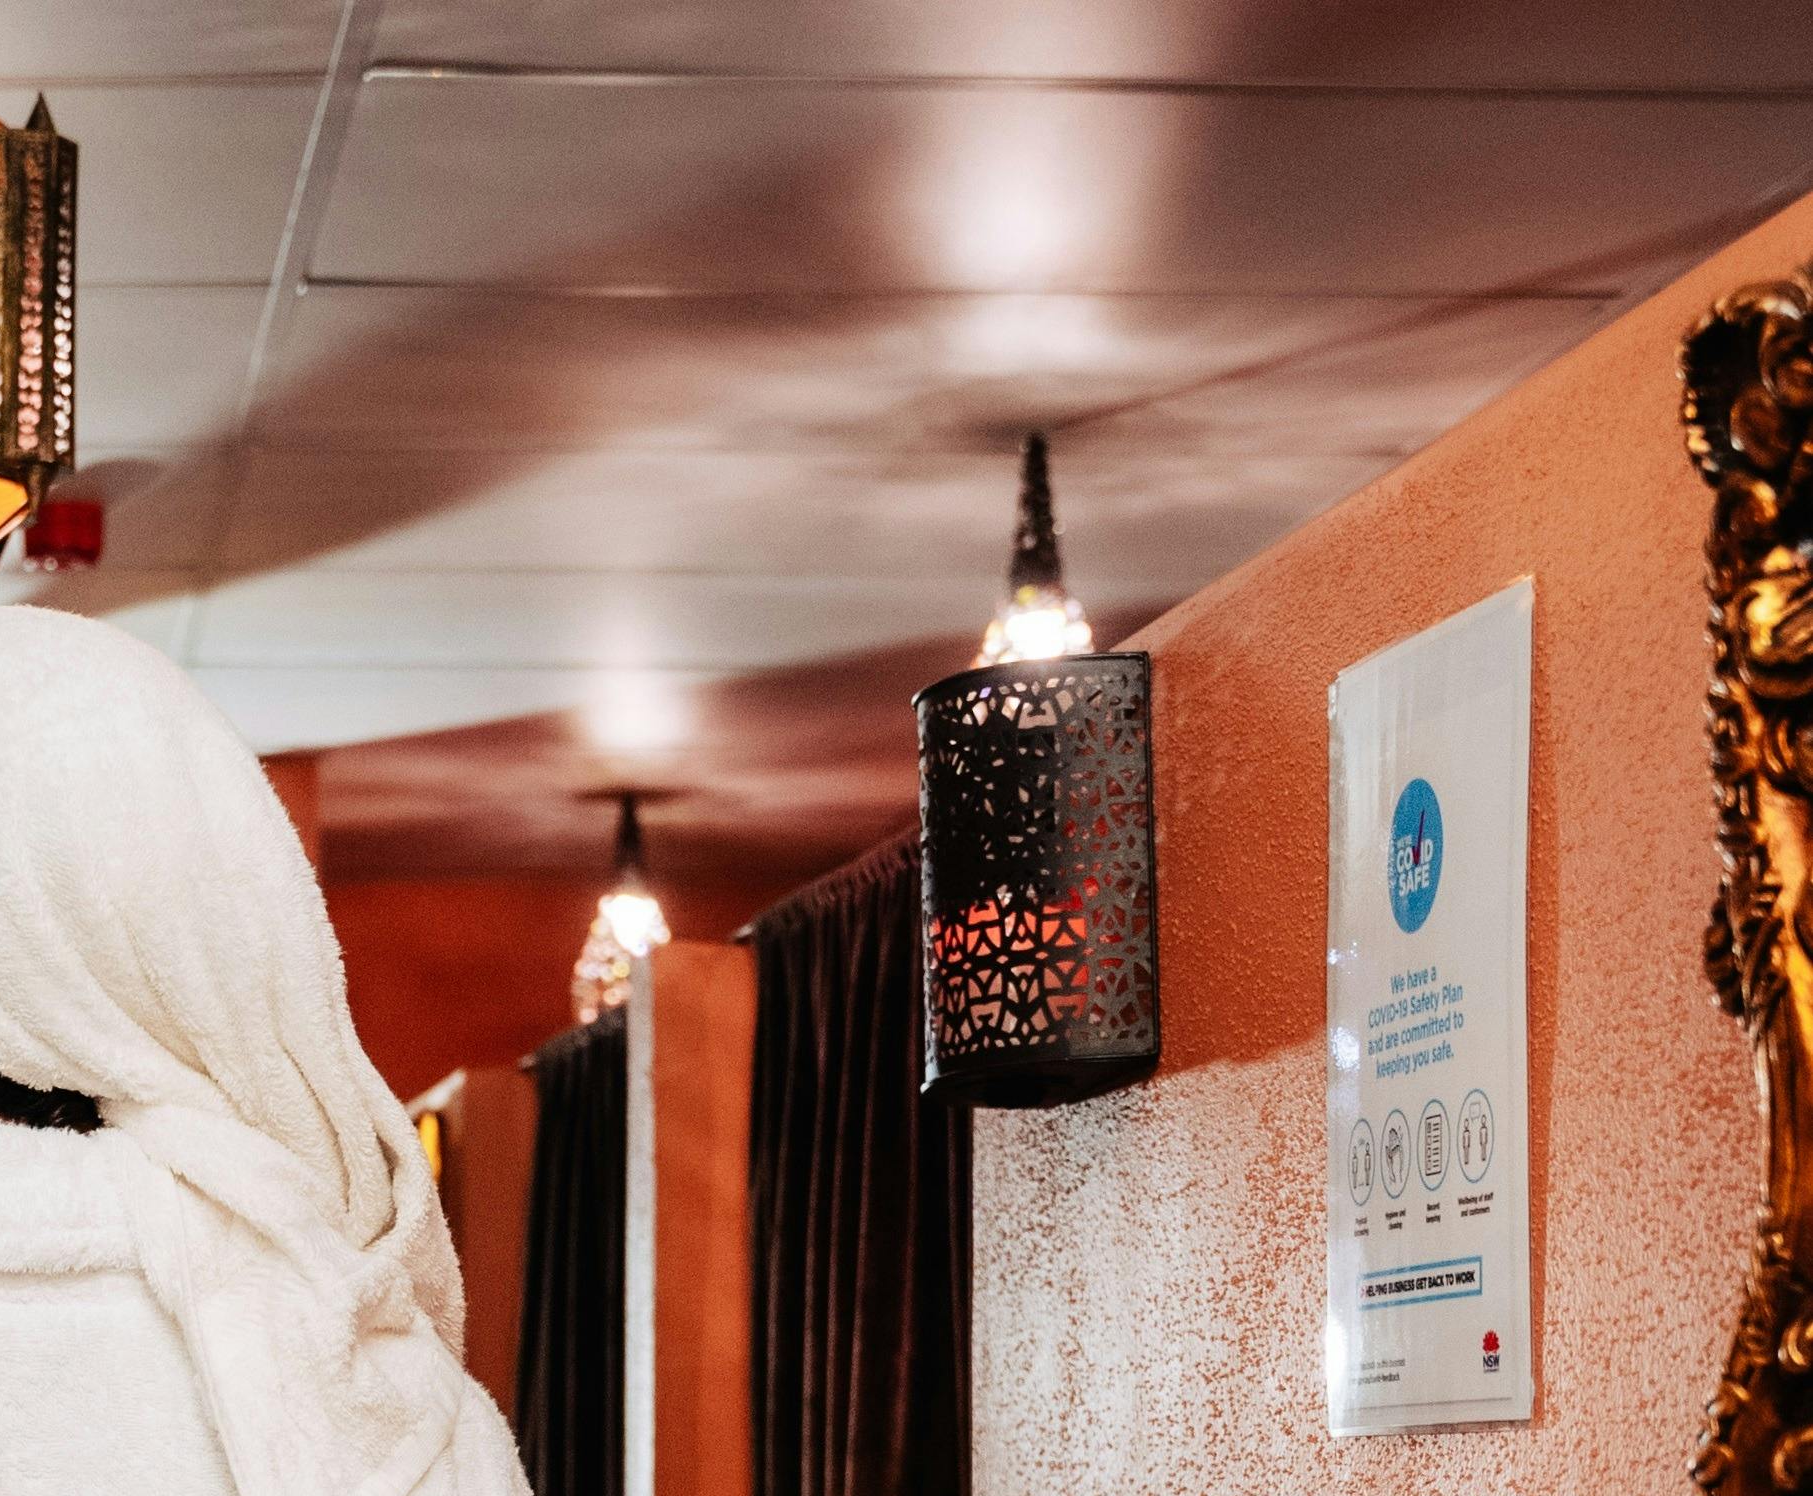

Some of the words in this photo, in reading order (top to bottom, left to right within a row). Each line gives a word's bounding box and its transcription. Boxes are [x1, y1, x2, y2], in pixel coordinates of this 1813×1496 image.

[1396, 838, 1434, 874] COVID
[1398, 864, 1430, 897] SAFE
[1390, 975, 1405, 995] We
[1407, 969, 1429, 991] have
[1430, 965, 1437, 982] a
[1368, 998, 1408, 1029] COVID-19
[1410, 991, 1439, 1015] Safety
[1442, 983, 1463, 1005] Plan
[1368, 1032, 1384, 1056] and
[1385, 1032, 1399, 1049] are
[1401, 1010, 1451, 1045] committed
[1453, 1010, 1464, 1029] to
[1376, 1053, 1411, 1080] keeping
[1412, 1050, 1430, 1073] you
[1432, 1040, 1455, 1063] safe.
[1388, 1279, 1415, 1294] BUSINESS
[1415, 1277, 1428, 1290] GET
[1427, 1275, 1444, 1289] BACK
[1445, 1273, 1455, 1286] TO
[1455, 1270, 1476, 1285] WORK
[1483, 1354, 1500, 1368] NSW
